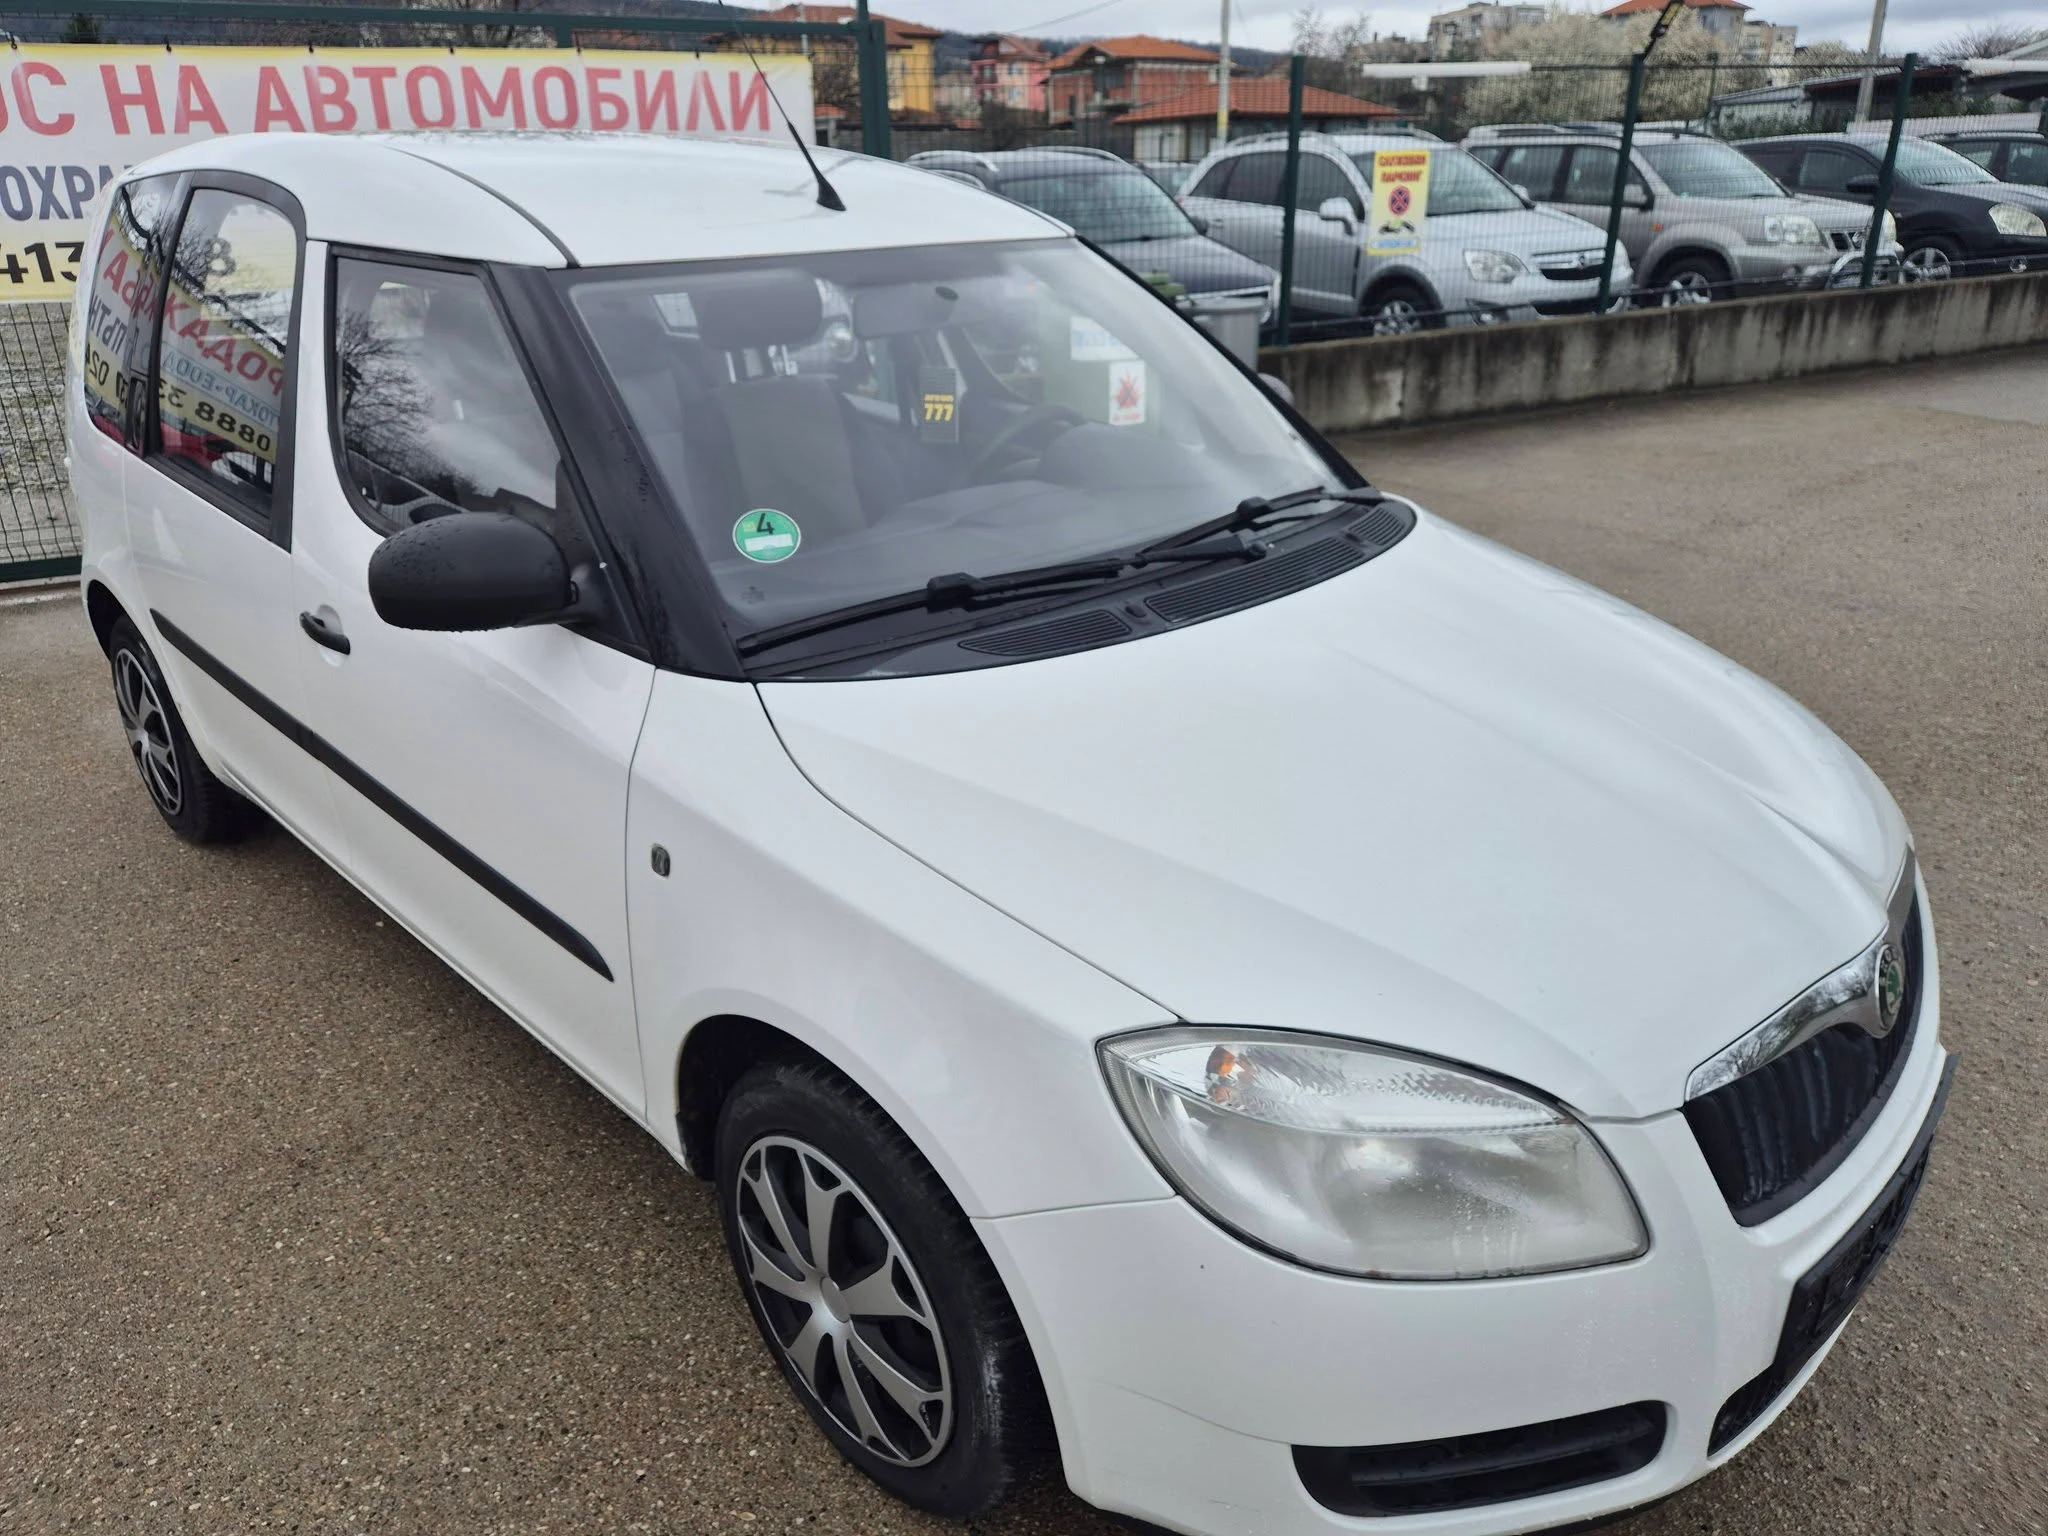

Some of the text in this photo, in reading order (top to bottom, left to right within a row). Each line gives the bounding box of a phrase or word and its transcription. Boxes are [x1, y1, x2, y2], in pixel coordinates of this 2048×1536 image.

[0, 61, 771, 136] С НА АВТОМОБИЛИ
[924, 403, 954, 421] 777
[757, 513, 775, 535] 4
